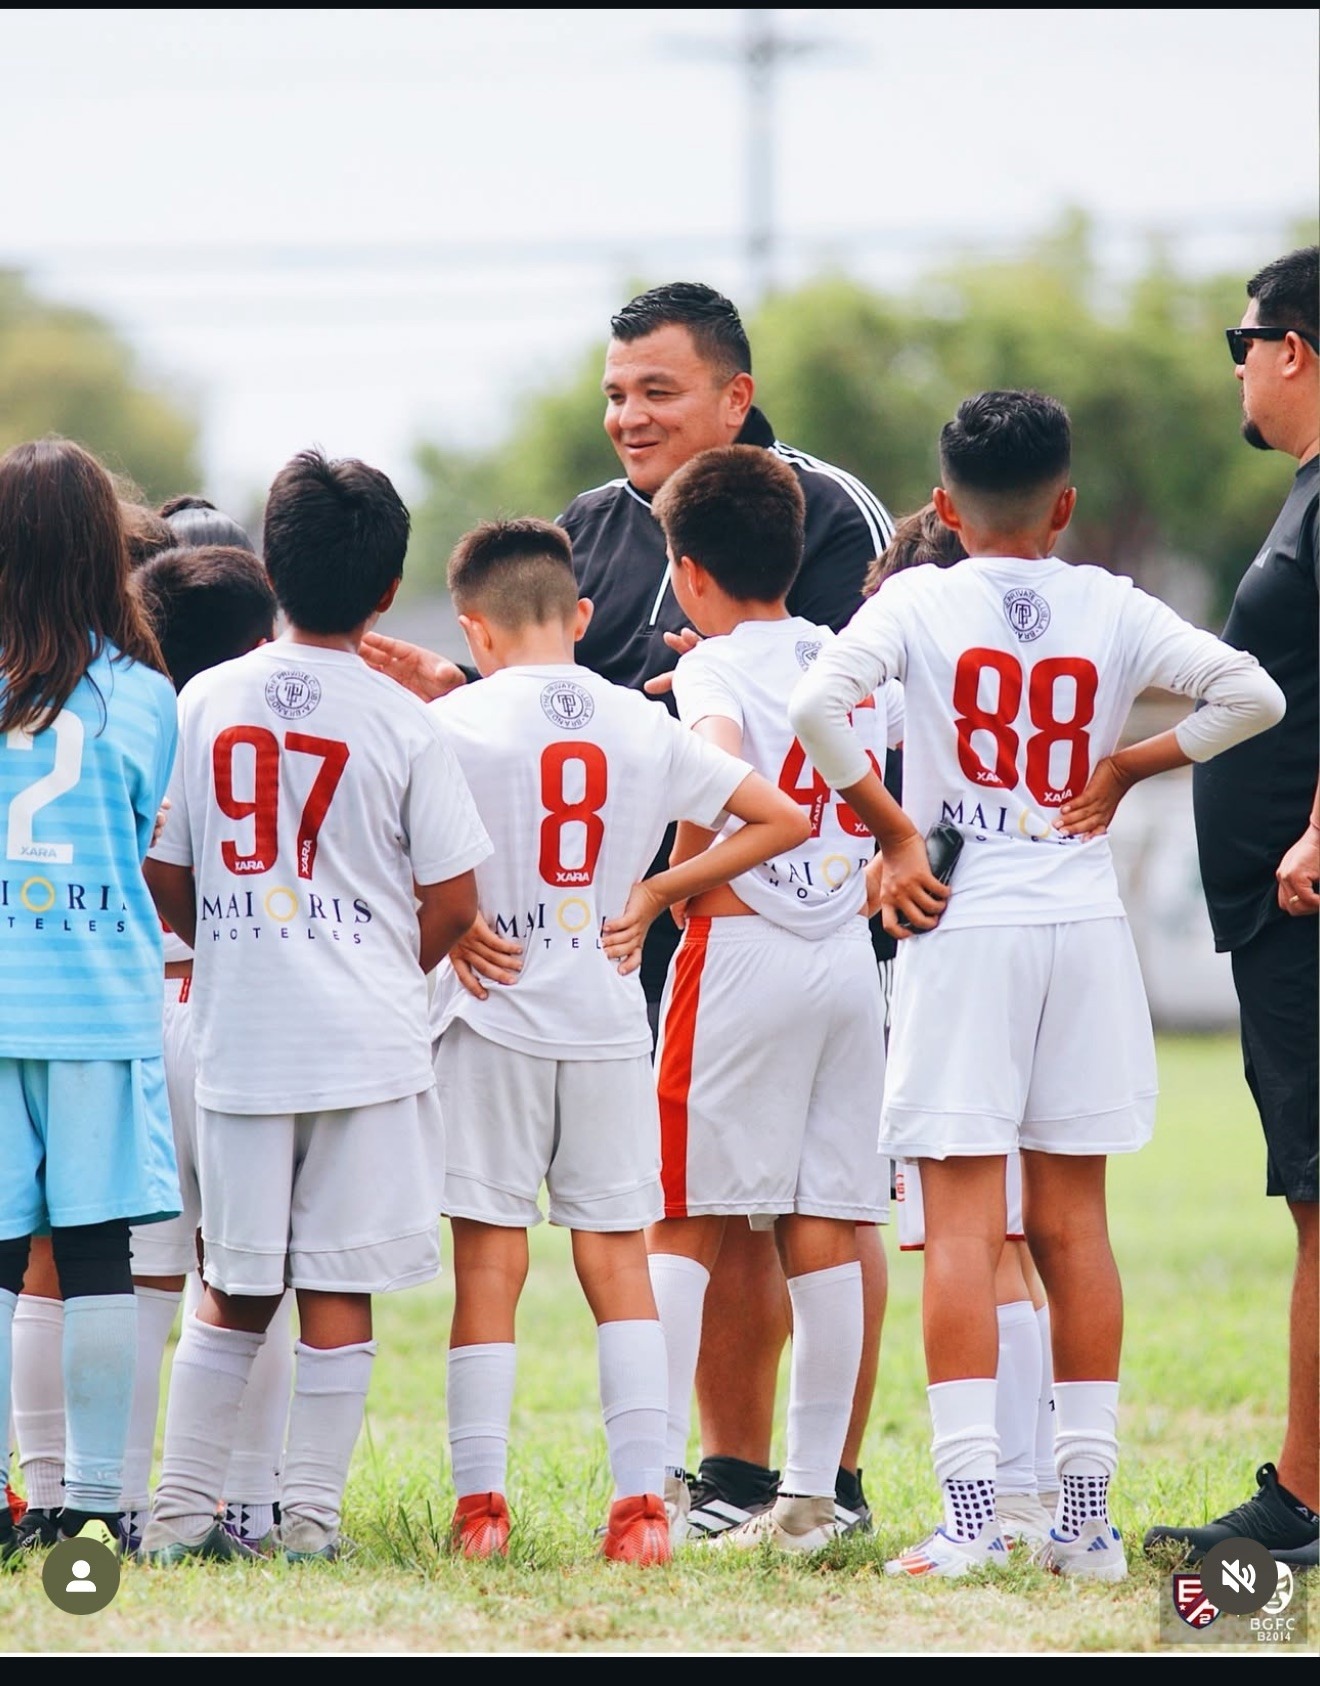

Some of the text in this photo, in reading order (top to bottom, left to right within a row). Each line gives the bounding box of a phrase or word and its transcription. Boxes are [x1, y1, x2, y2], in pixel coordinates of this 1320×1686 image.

[953, 646, 1099, 808] 88
[6, 706, 84, 864] 2
[213, 725, 350, 880] 97
[539, 741, 607, 887] 8
[2, 876, 128, 912] IORI
[20, 846, 58, 858] XARA
[201, 886, 373, 923] MAIORIS
[213, 927, 361, 944] HOTELES
